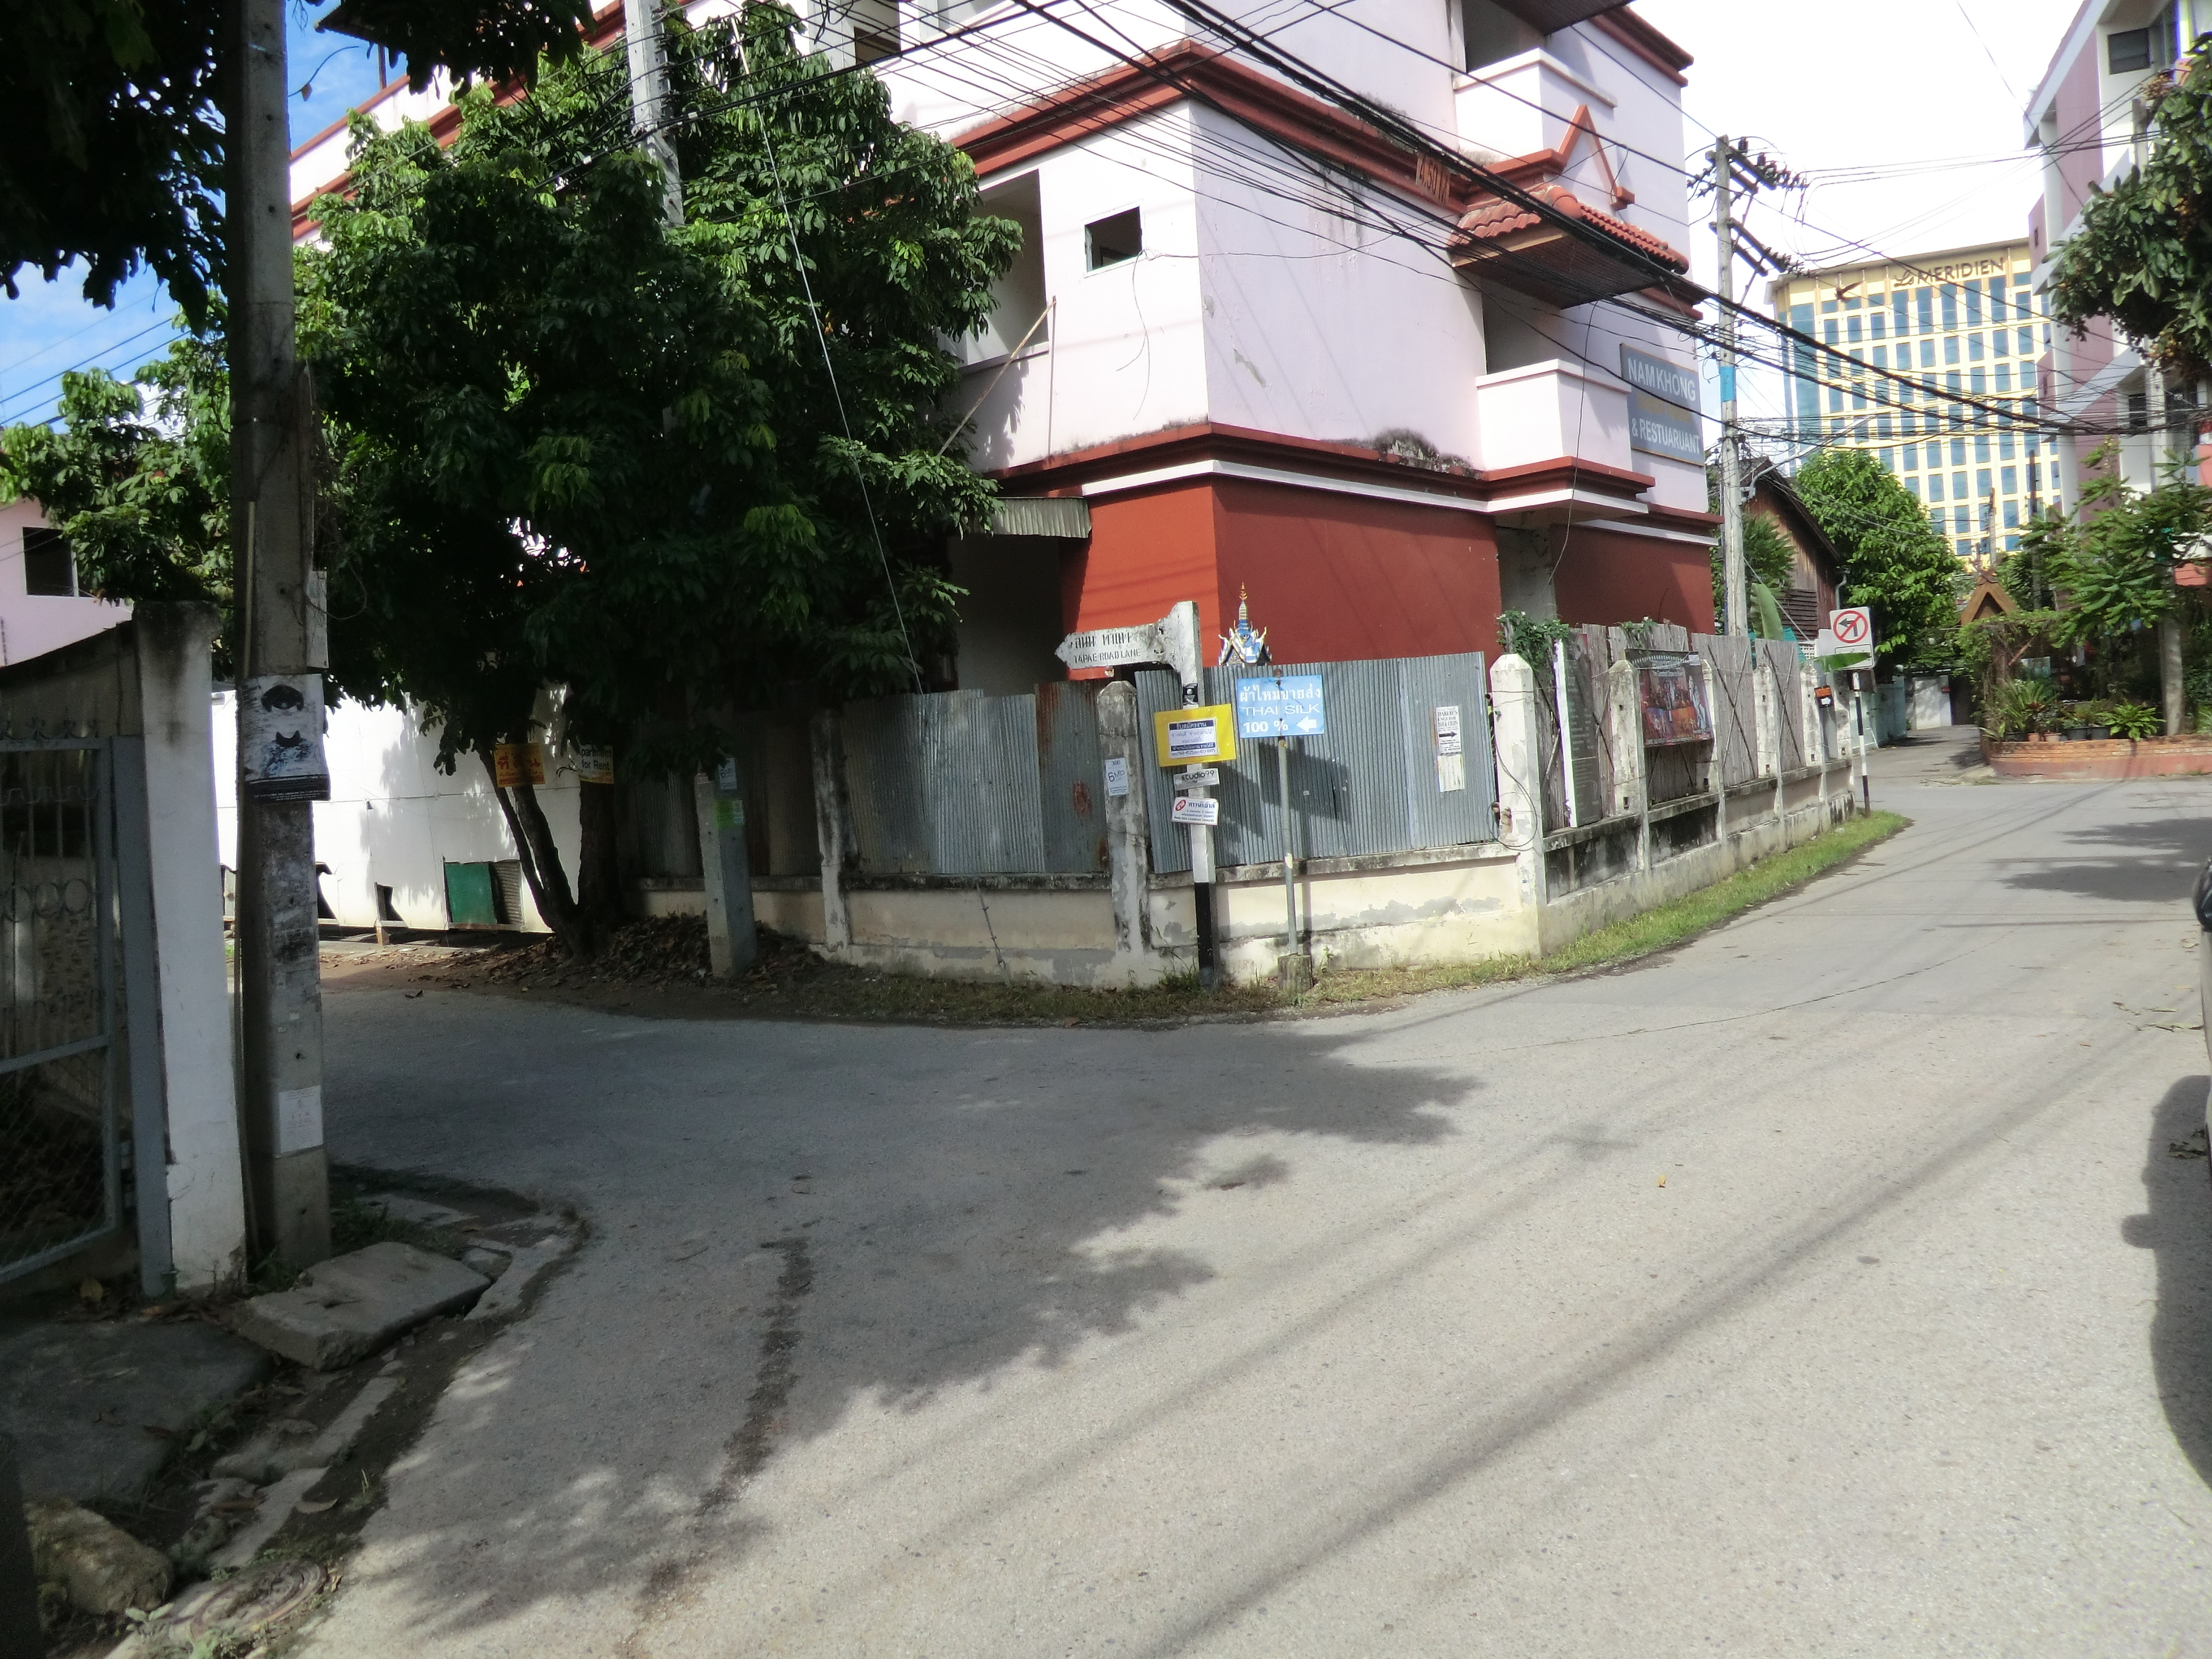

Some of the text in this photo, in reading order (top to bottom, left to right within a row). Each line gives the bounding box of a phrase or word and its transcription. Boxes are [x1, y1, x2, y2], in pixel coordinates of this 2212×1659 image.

[1631, 418, 1700, 454] & RESTUARUANT
[1074, 648, 1141, 664] TAPAE ROAD LANE
[1242, 703, 1320, 716] THAI SILK
[1243, 720, 1289, 733] 100 %
[580, 748, 612, 759] partment
[581, 759, 610, 771] for Rent
